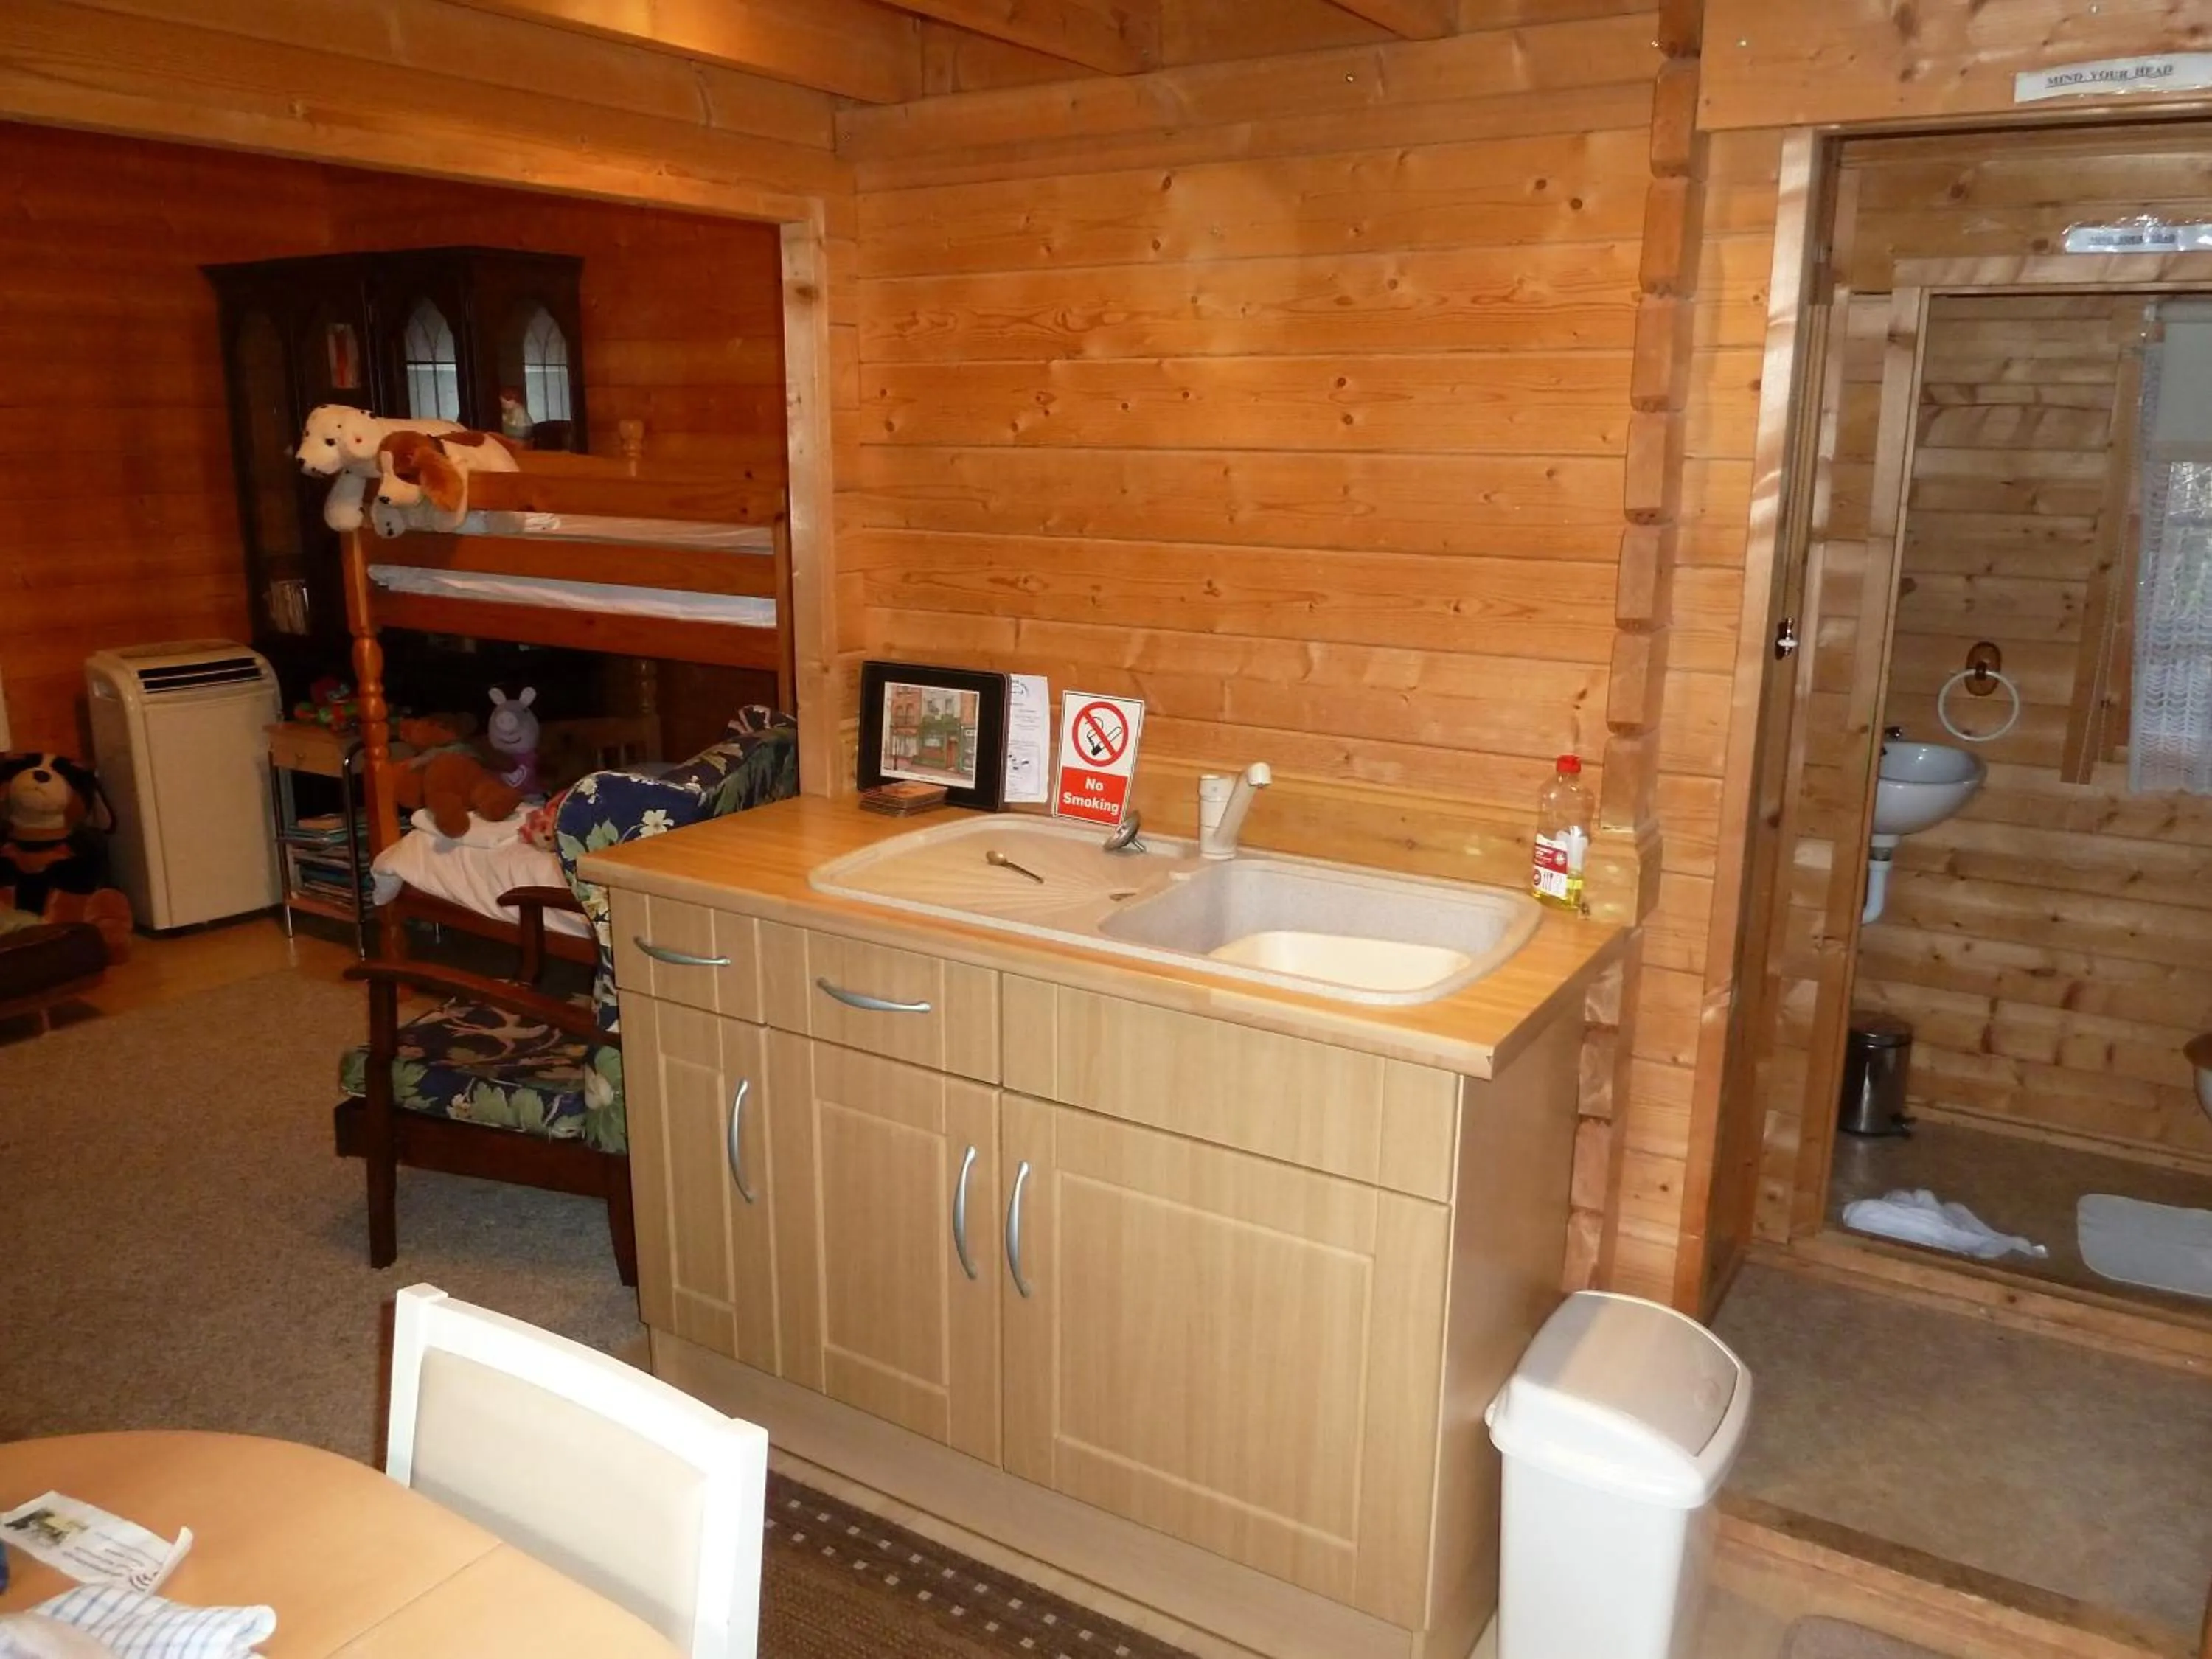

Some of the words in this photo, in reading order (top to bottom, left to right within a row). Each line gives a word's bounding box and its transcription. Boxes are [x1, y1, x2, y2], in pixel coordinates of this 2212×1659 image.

[2046, 72, 2084, 86] MIND
[2090, 70, 2129, 82] YOUR
[2135, 64, 2174, 78] HEAD
[1085, 776, 1104, 792] No
[1062, 792, 1119, 815] Smoking
